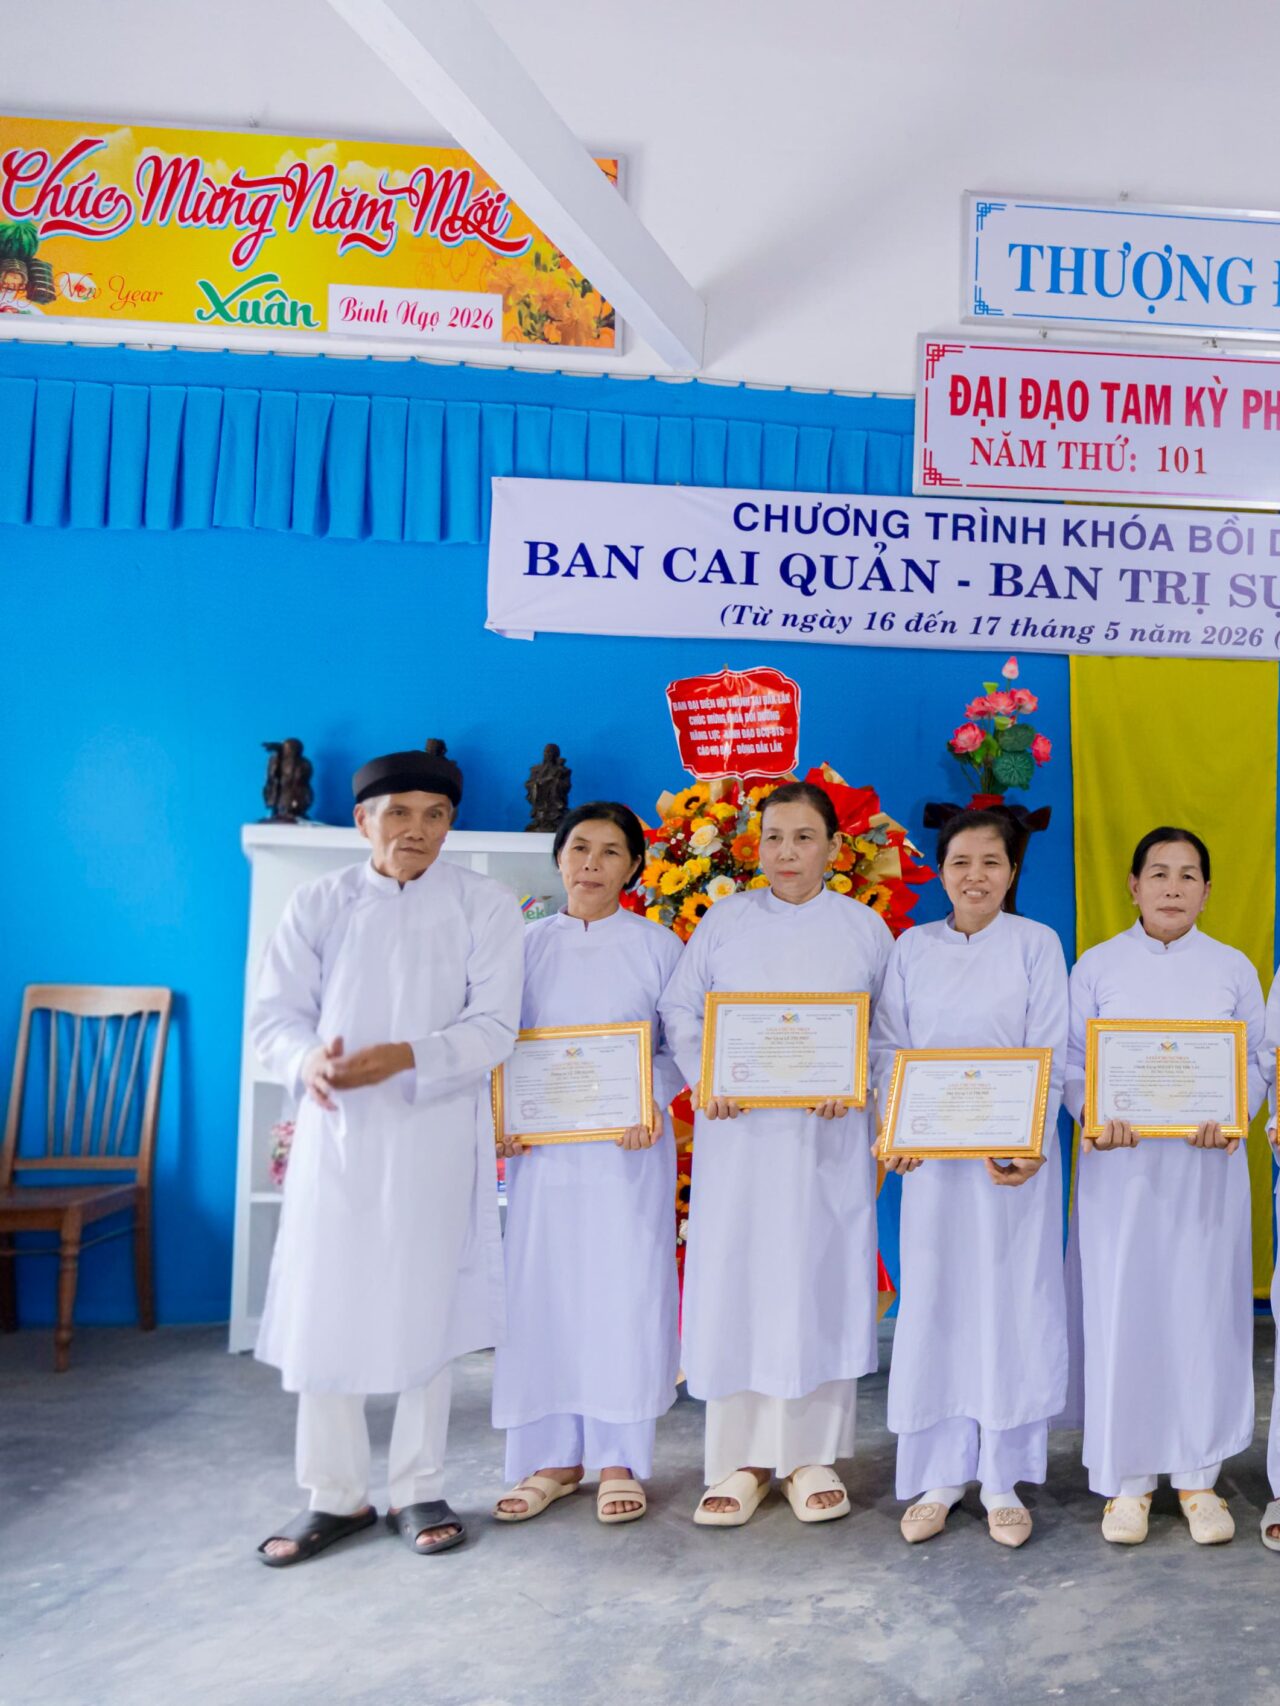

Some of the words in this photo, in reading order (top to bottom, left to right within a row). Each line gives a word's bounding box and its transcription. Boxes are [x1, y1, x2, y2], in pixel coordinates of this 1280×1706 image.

[2, 138, 132, 237] Chúc
[136, 155, 279, 267] Mừng
[231, 162, 396, 253] Năm
[379, 167, 530, 252] Mới
[53, 271, 101, 299] New
[108, 274, 163, 312] Year
[197, 273, 320, 327] Xuân
[1008, 241, 1257, 315] THƯỢNG
[396, 300, 441, 332] Ngọ
[448, 306, 494, 330] 2026
[949, 374, 1008, 427] ĐẠI
[1019, 377, 1090, 430] ĐẠO
[1100, 382, 1173, 426] TAM
[1185, 375, 1229, 428] KỲ
[971, 431, 1047, 469] NĂM
[1058, 433, 1137, 473] THỨ:
[1158, 446, 1209, 475] 101
[733, 502, 910, 540] CHƯƠNG
[925, 507, 1046, 547] TRÌNH
[1062, 514, 1175, 552] KHÓA
[1188, 514, 1255, 557] BỒI
[523, 540, 645, 581] BAN
[662, 546, 760, 587] CAI
[779, 541, 941, 597] QUẢN
[957, 579, 971, 587] -
[988, 562, 1103, 602] BAN
[1119, 568, 1211, 616] TRỊ
[720, 602, 774, 628] (Từ
[781, 609, 853, 635] ngày
[864, 611, 896, 632] 16
[905, 610, 958, 635] đến
[968, 615, 1001, 636] 17
[1010, 616, 1095, 645] tháng
[1104, 622, 1121, 641] 5
[1130, 623, 1192, 645] năm
[1201, 625, 1265, 647] 2026
